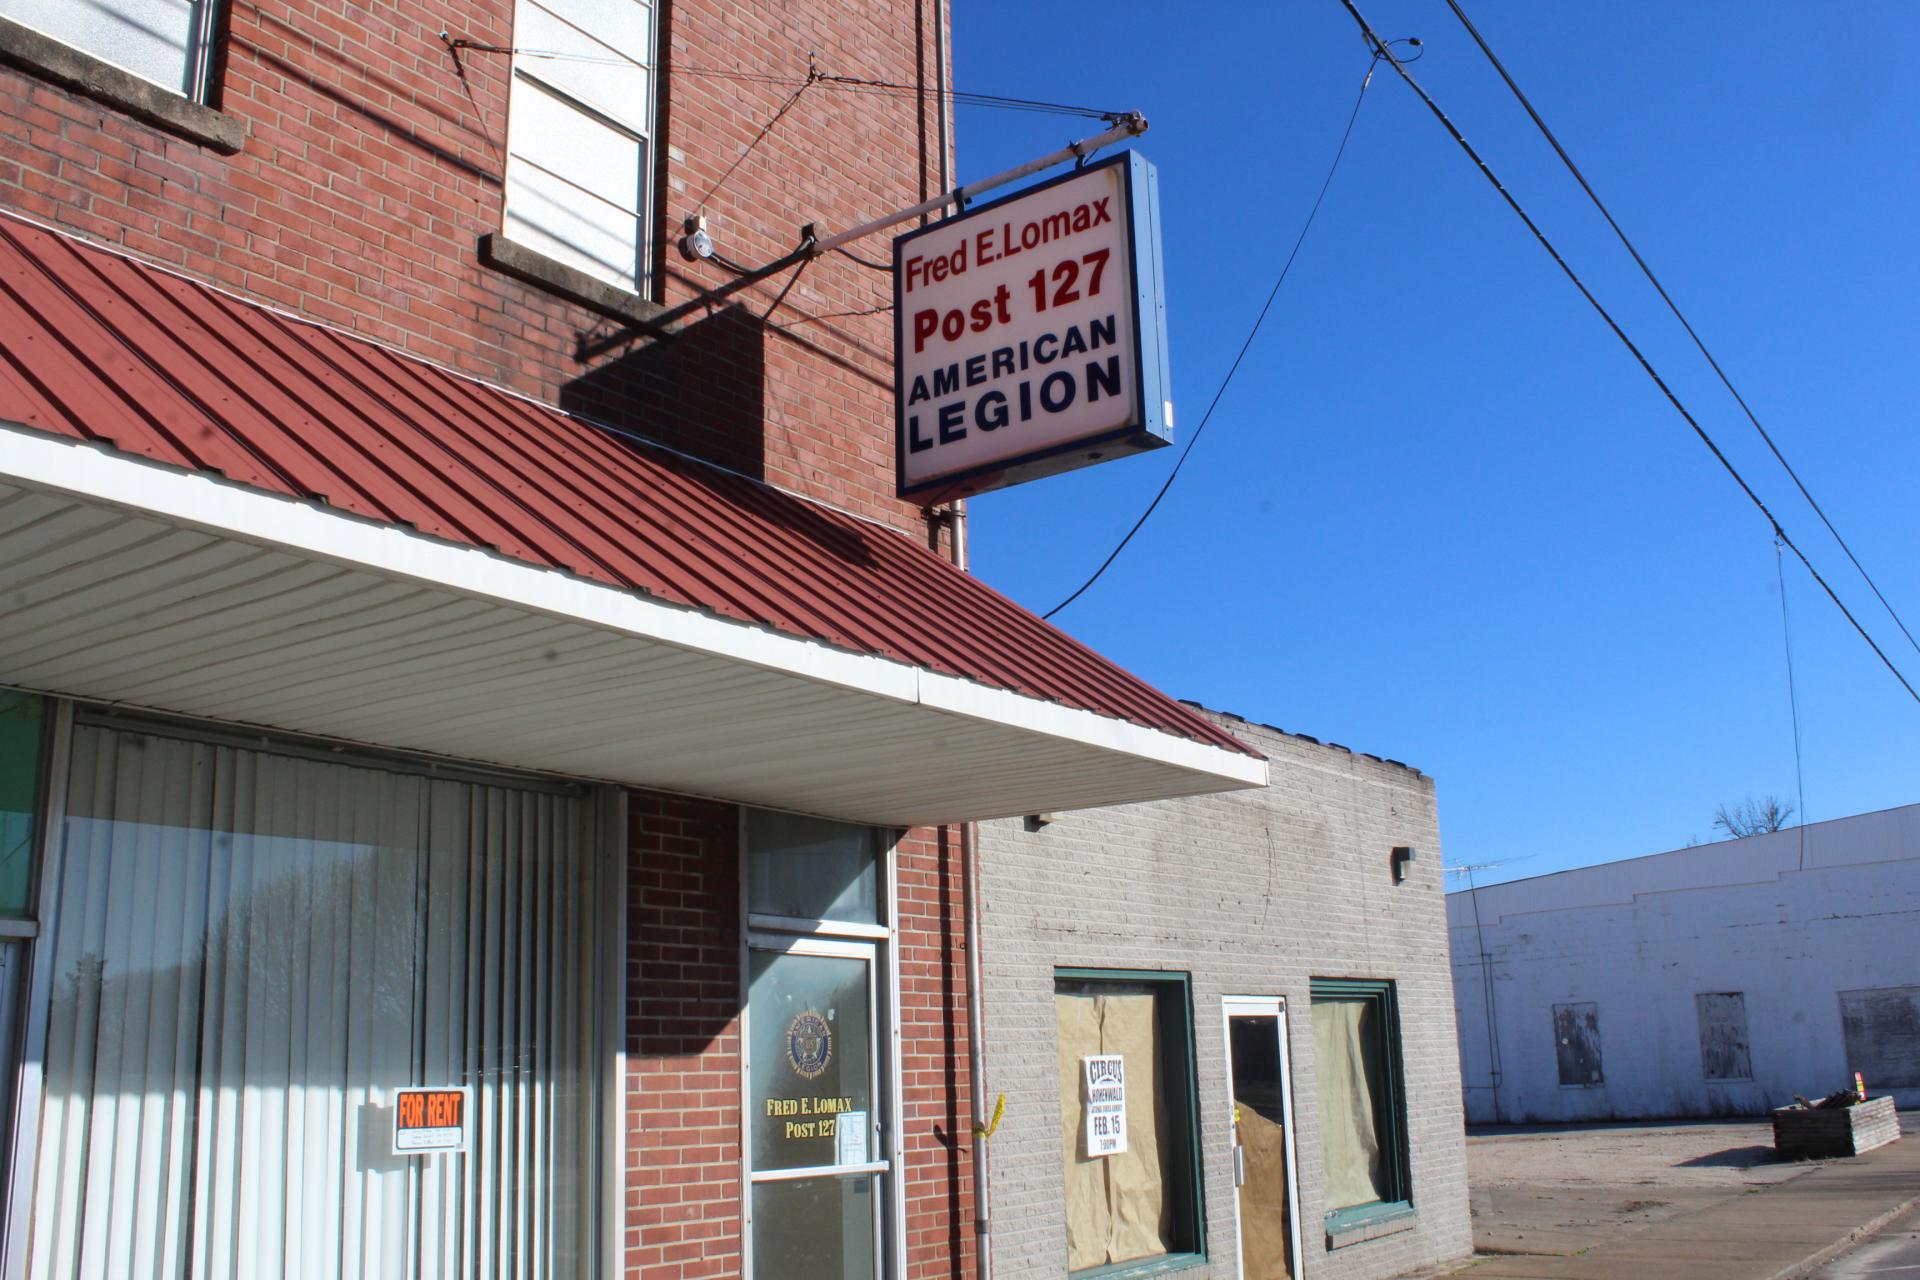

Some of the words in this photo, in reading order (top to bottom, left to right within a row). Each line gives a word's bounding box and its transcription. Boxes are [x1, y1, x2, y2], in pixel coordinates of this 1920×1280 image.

[906, 239, 967, 293] Fred
[914, 284, 1011, 354] Post
[1028, 248, 1111, 313] 127
[908, 315, 1117, 406] AMERICAN
[909, 356, 1121, 454] LEGION
[1089, 1060, 1122, 1084] CIRCUS
[399, 1094, 424, 1128] FOR
[427, 1094, 461, 1127] RENT
[766, 1098, 798, 1116] FRED
[801, 1097, 812, 1115] E.
[813, 1096, 852, 1114] LOMAX
[786, 1121, 815, 1139] POST
[818, 1119, 835, 1137] 127
[1094, 1116, 1110, 1136] FEB.
[1111, 1115, 1120, 1133] 15
